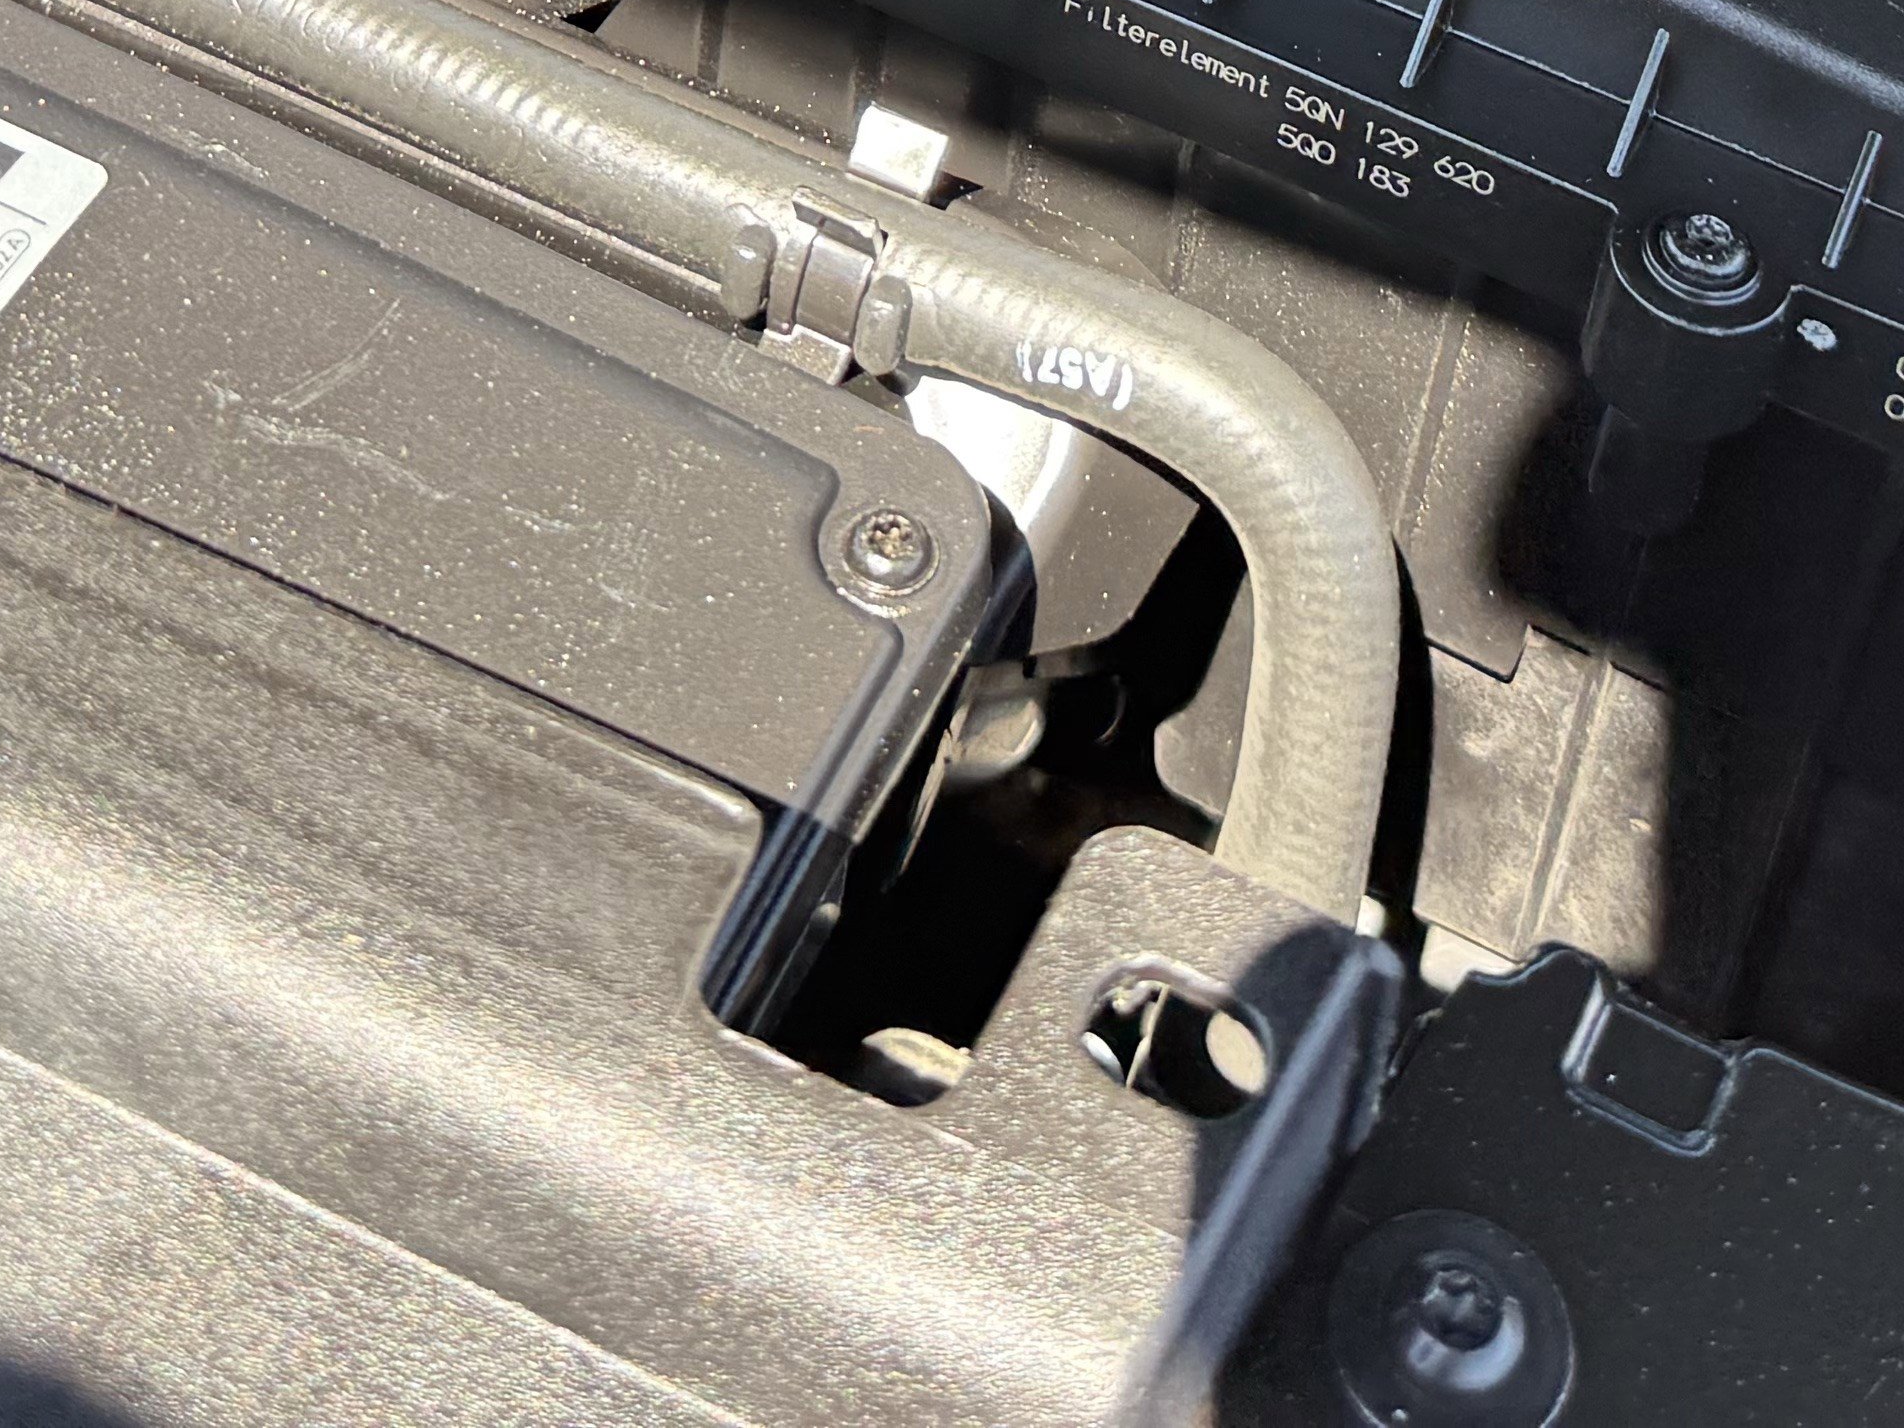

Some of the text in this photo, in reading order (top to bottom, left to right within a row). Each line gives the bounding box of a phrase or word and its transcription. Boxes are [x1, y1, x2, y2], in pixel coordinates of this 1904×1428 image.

[1284, 85, 1346, 132] 5QN
[1365, 120, 1420, 161] 129
[1433, 154, 1496, 196] 620
[1356, 157, 1412, 200] 183
[5, 237, 24, 251] A
